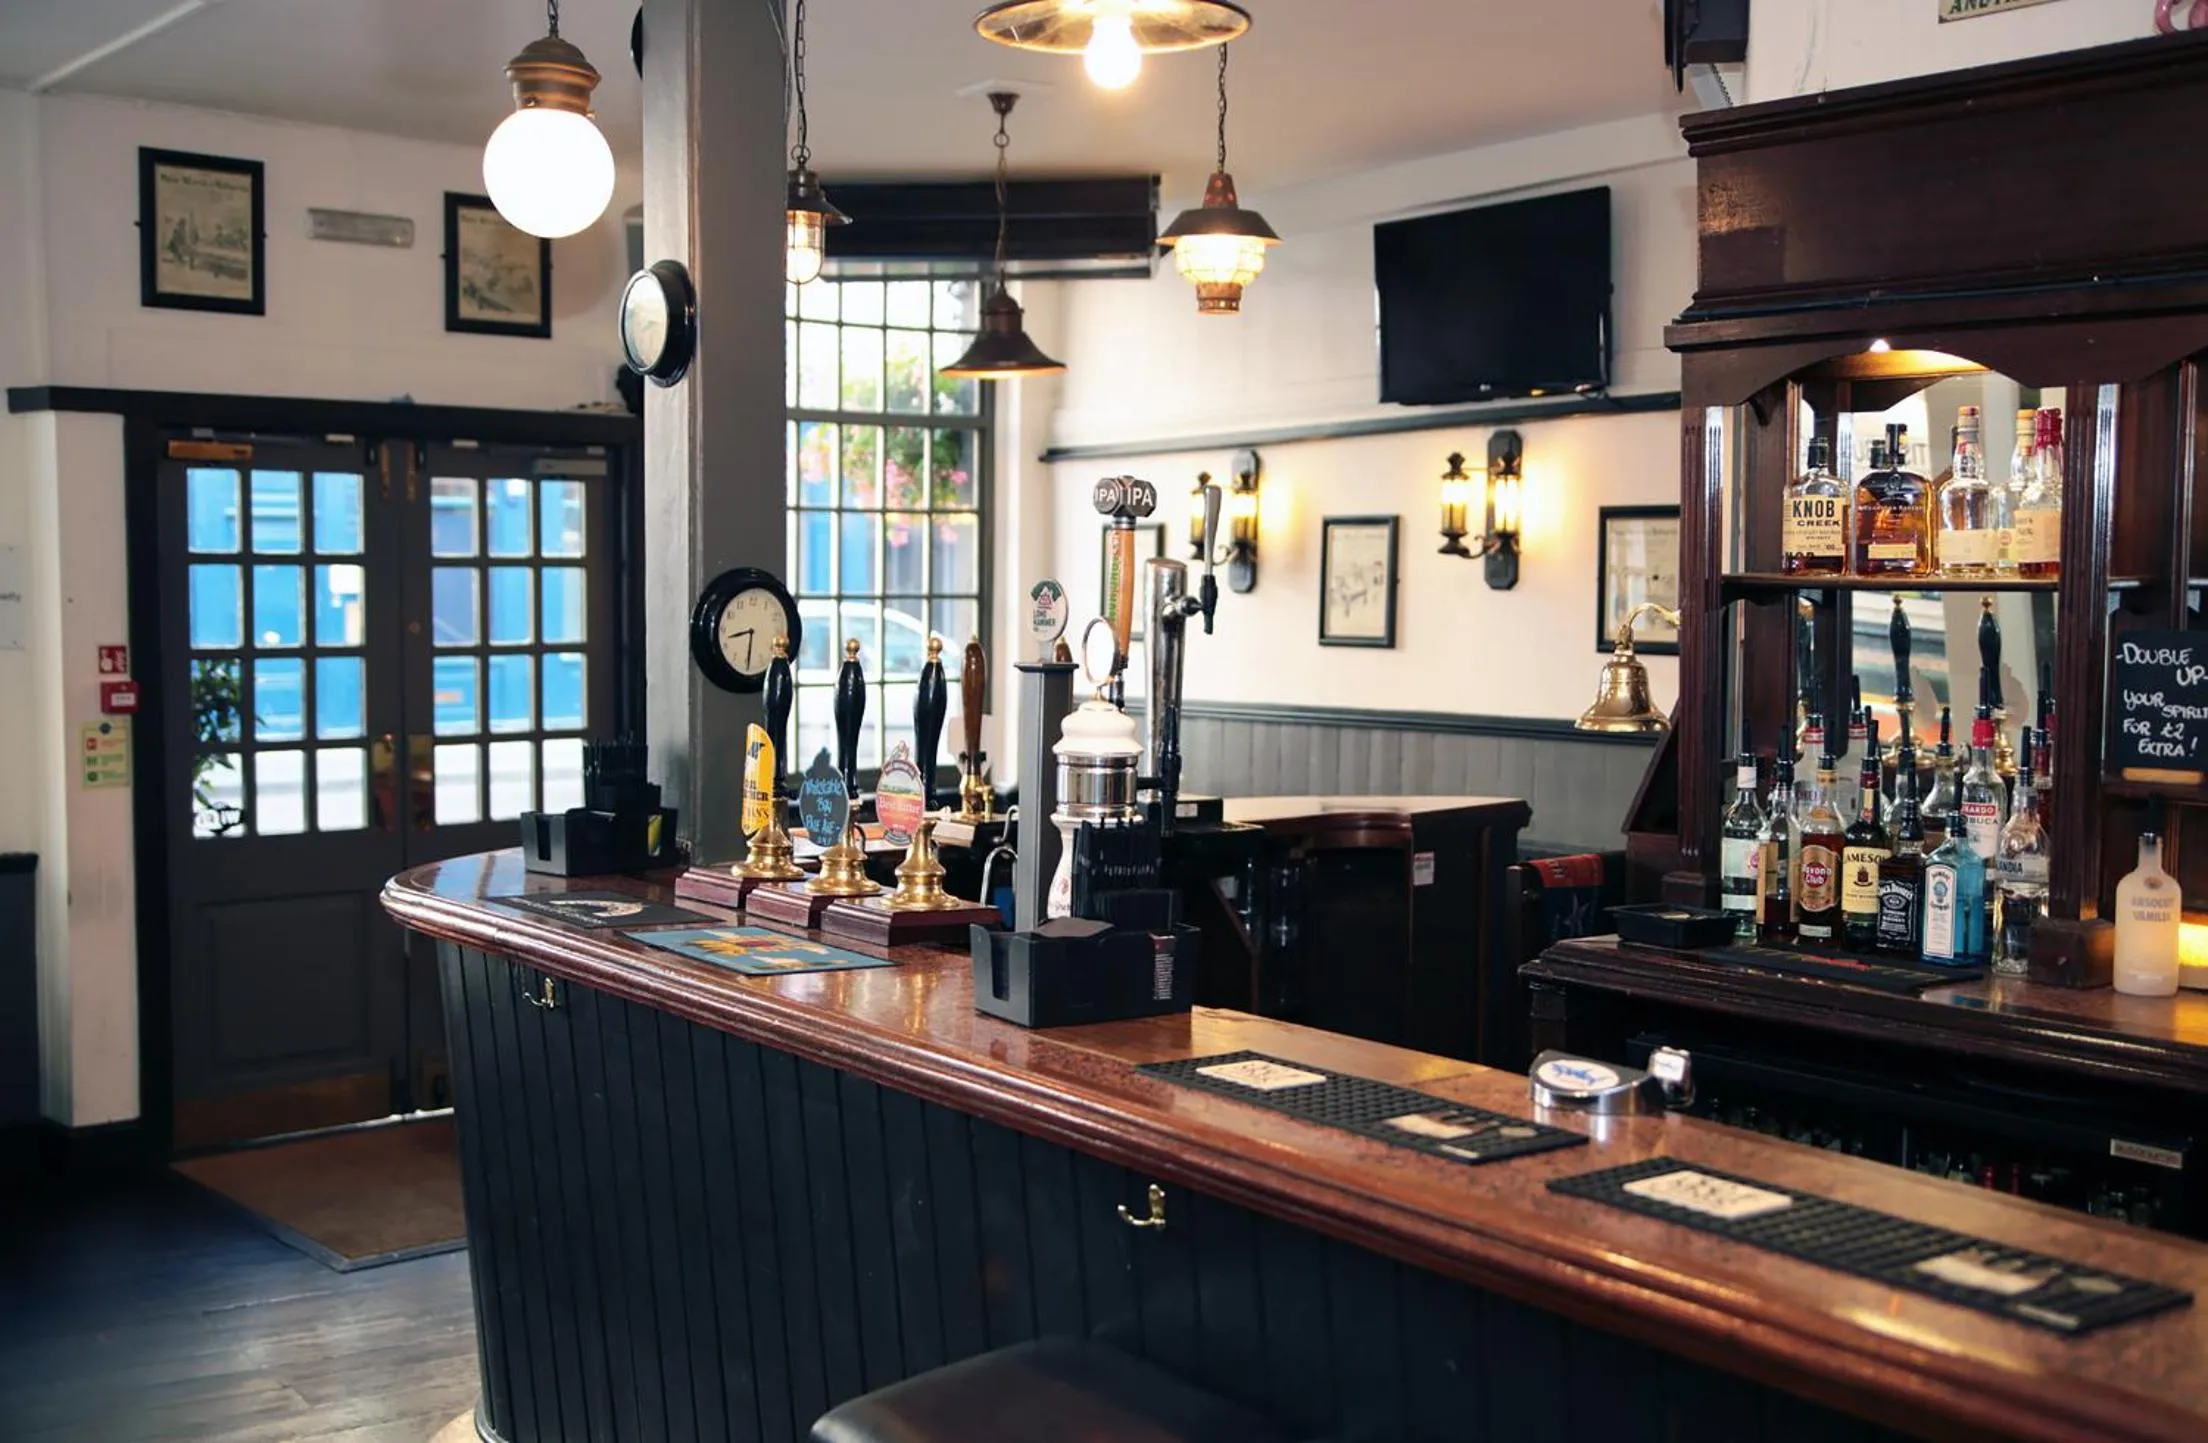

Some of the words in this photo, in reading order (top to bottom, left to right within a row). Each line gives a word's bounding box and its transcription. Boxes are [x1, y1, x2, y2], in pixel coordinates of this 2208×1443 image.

[1095, 488, 1117, 502] IPA
[1127, 487, 1154, 506] IPA
[1792, 500, 1836, 518] KNOB
[1796, 519, 1841, 527] CREEK
[2122, 717, 2151, 736] FOR
[2160, 721, 2185, 740] £2
